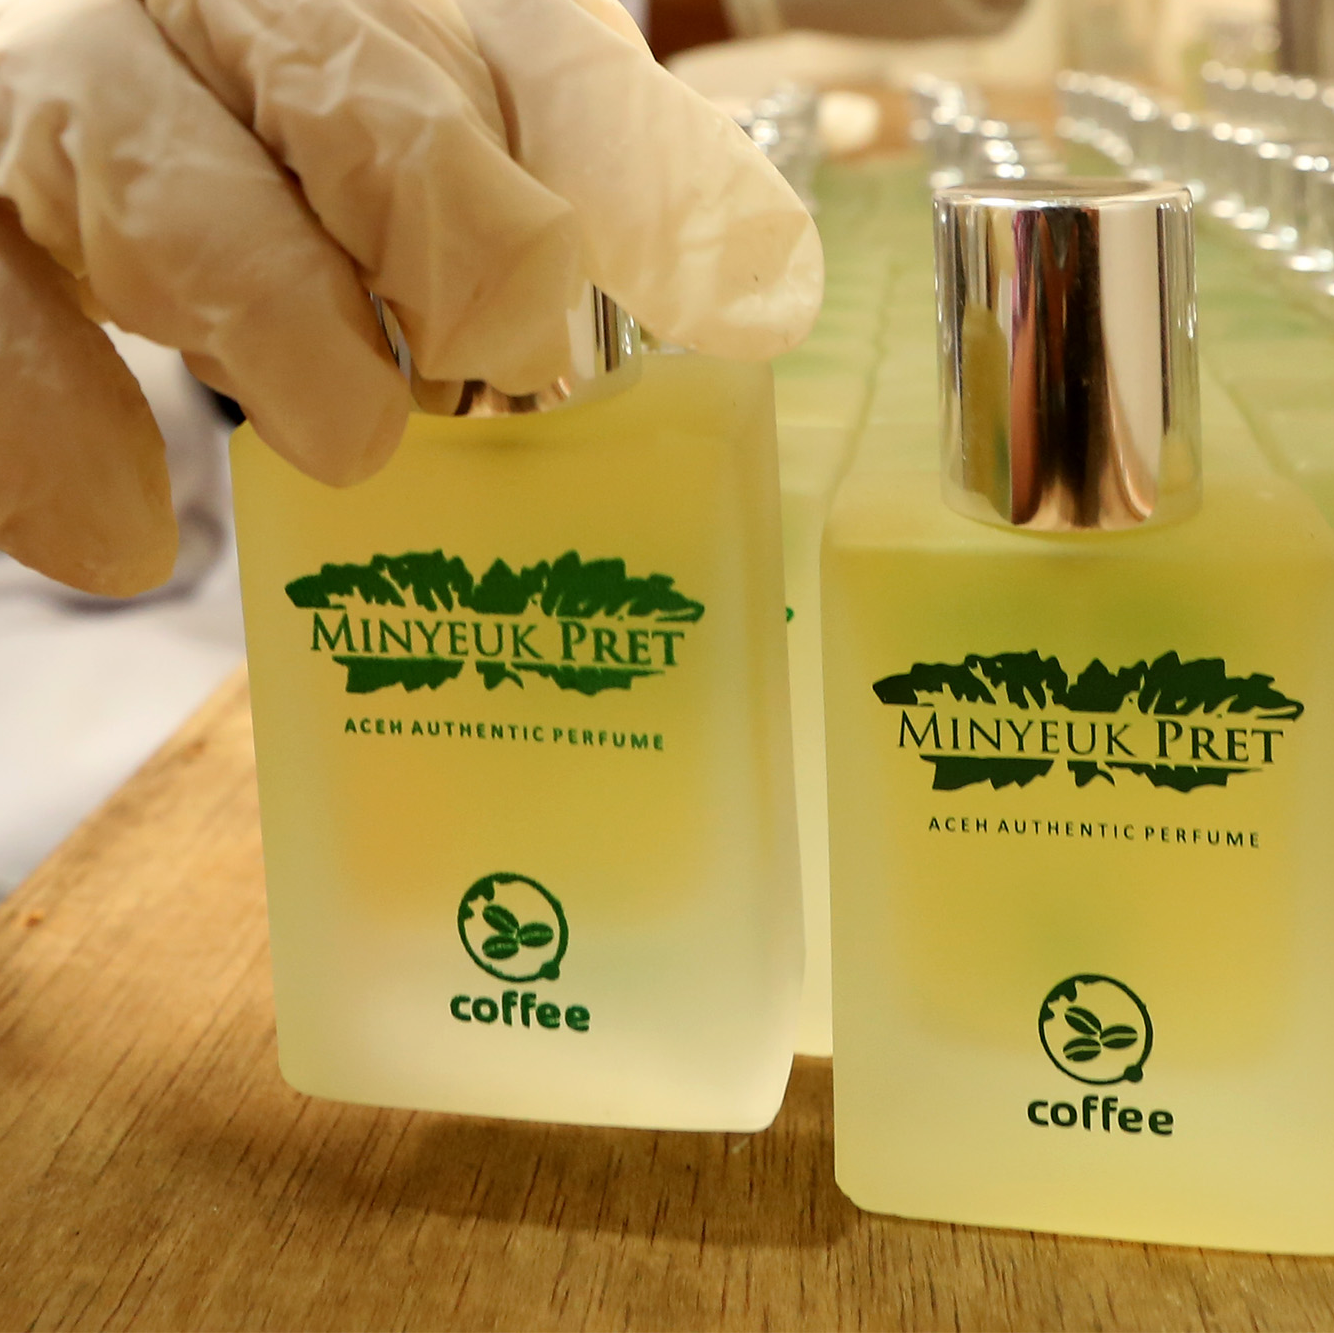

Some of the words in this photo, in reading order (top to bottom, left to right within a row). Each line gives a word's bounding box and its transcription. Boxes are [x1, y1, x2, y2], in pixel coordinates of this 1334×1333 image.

[310, 612, 544, 660] MINYEUK
[560, 620, 686, 666] PRET
[344, 717, 403, 735] ACEH
[411, 721, 544, 743] AUTHENTIC
[553, 728, 665, 750] PERFUME
[898, 710, 1137, 758] MINYEUK
[1155, 720, 1284, 764] PRET
[928, 816, 988, 833] ACEH
[997, 819, 1135, 841] AUTHENTIC
[1145, 826, 1260, 849] PERFUME
[450, 990, 591, 1032] coffee
[1027, 1095, 1174, 1136] coffee
